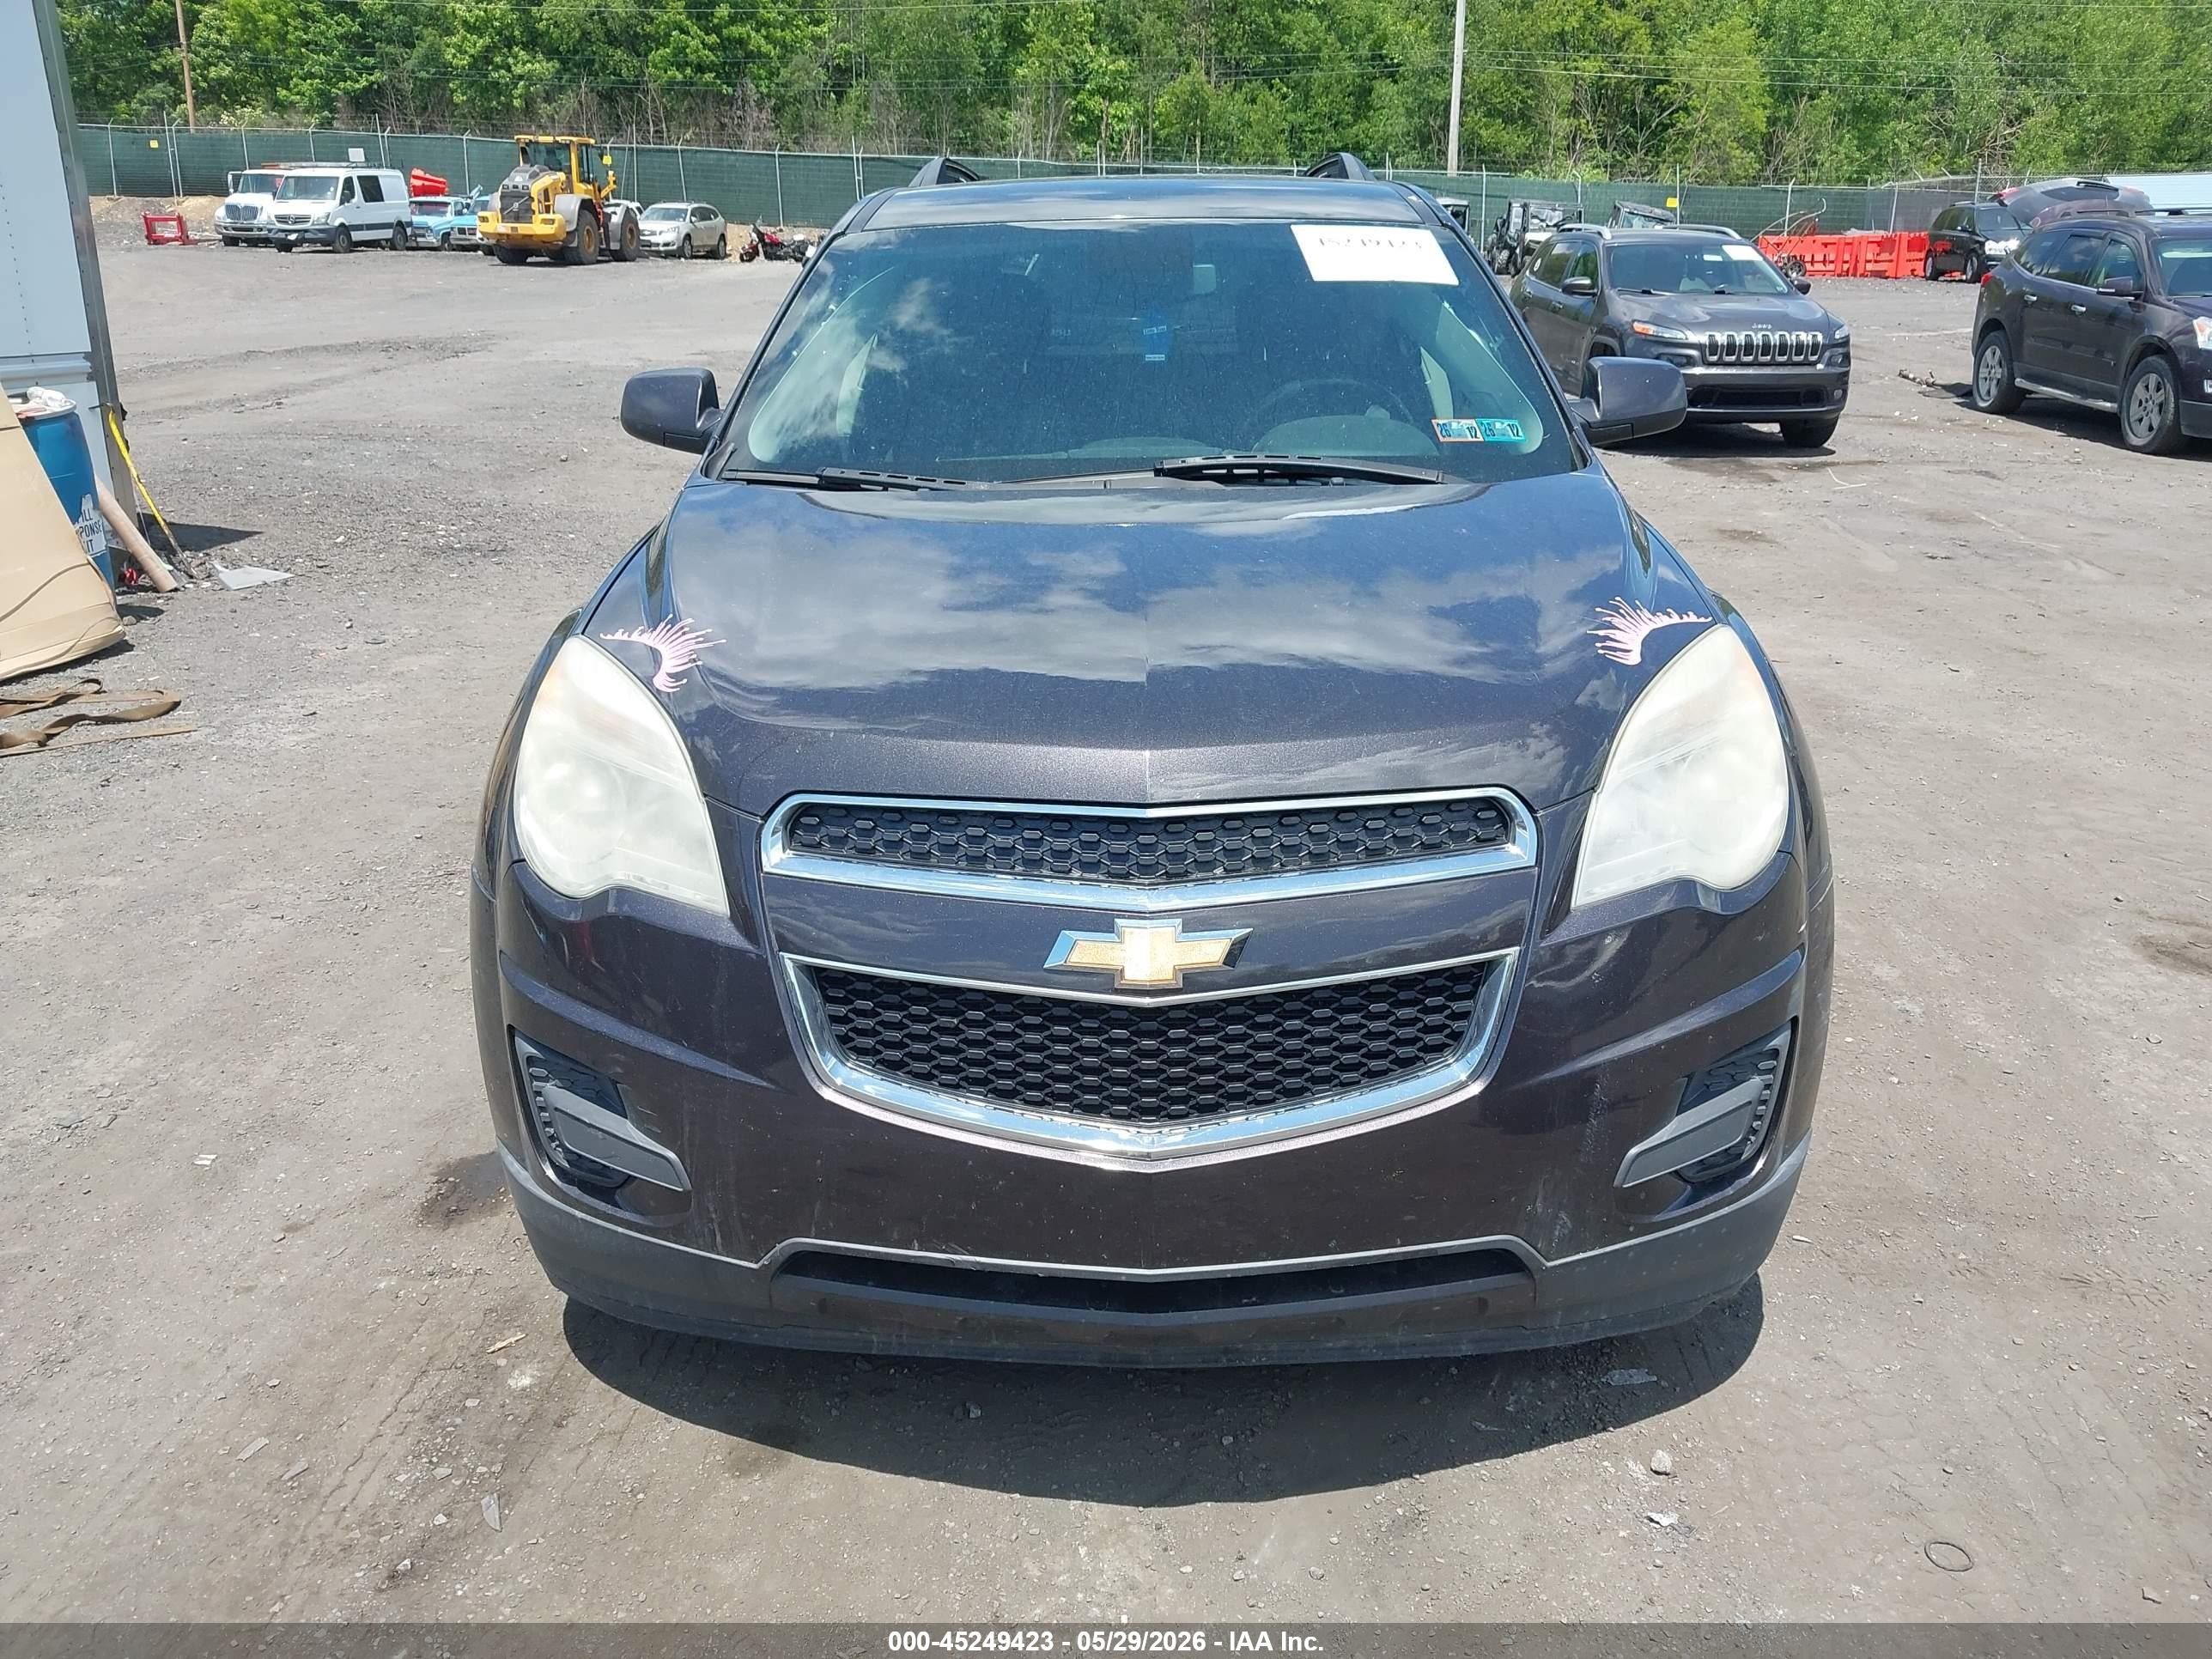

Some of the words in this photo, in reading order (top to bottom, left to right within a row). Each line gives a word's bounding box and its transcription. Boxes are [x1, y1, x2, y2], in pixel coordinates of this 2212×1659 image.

[1437, 422, 1451, 438] 26
[1466, 426, 1480, 439] 12
[1507, 423, 1522, 438] 12
[81, 508, 94, 523] ILL
[78, 520, 102, 538] PONSE
[85, 539, 94, 553] IT
